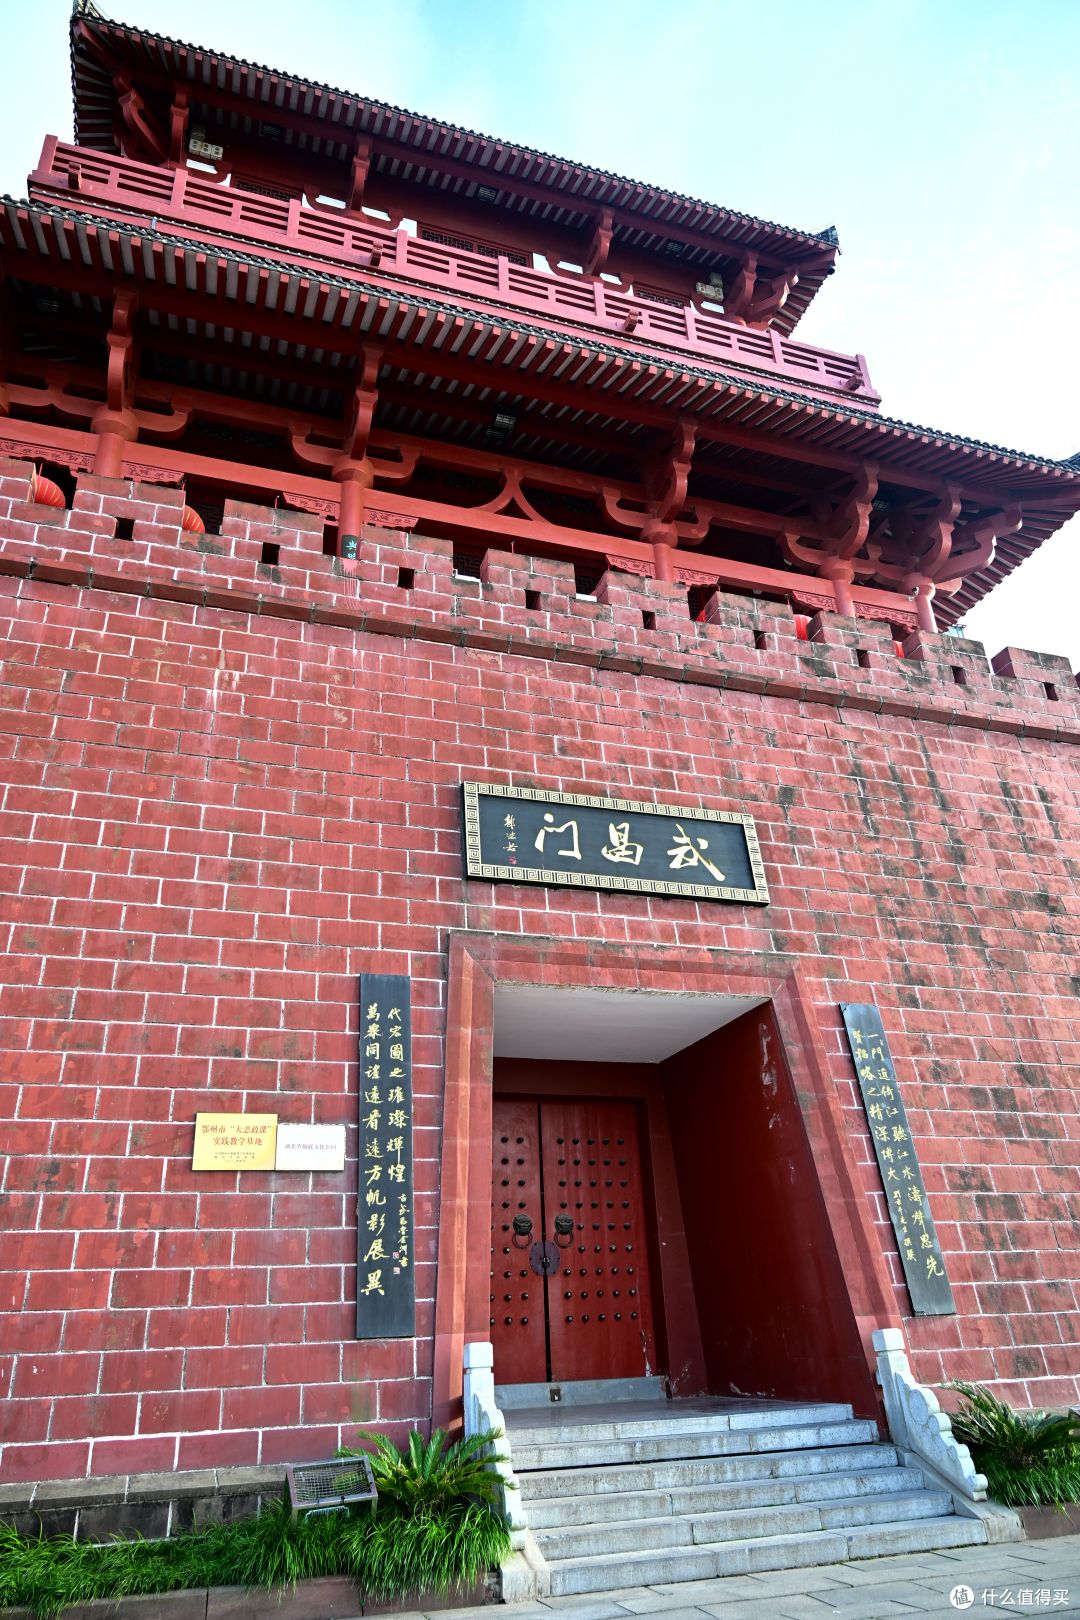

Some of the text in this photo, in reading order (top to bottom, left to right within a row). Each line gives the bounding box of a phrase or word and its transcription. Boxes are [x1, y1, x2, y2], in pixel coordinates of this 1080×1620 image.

[213, 1137, 263, 1146] 实践教学基地
